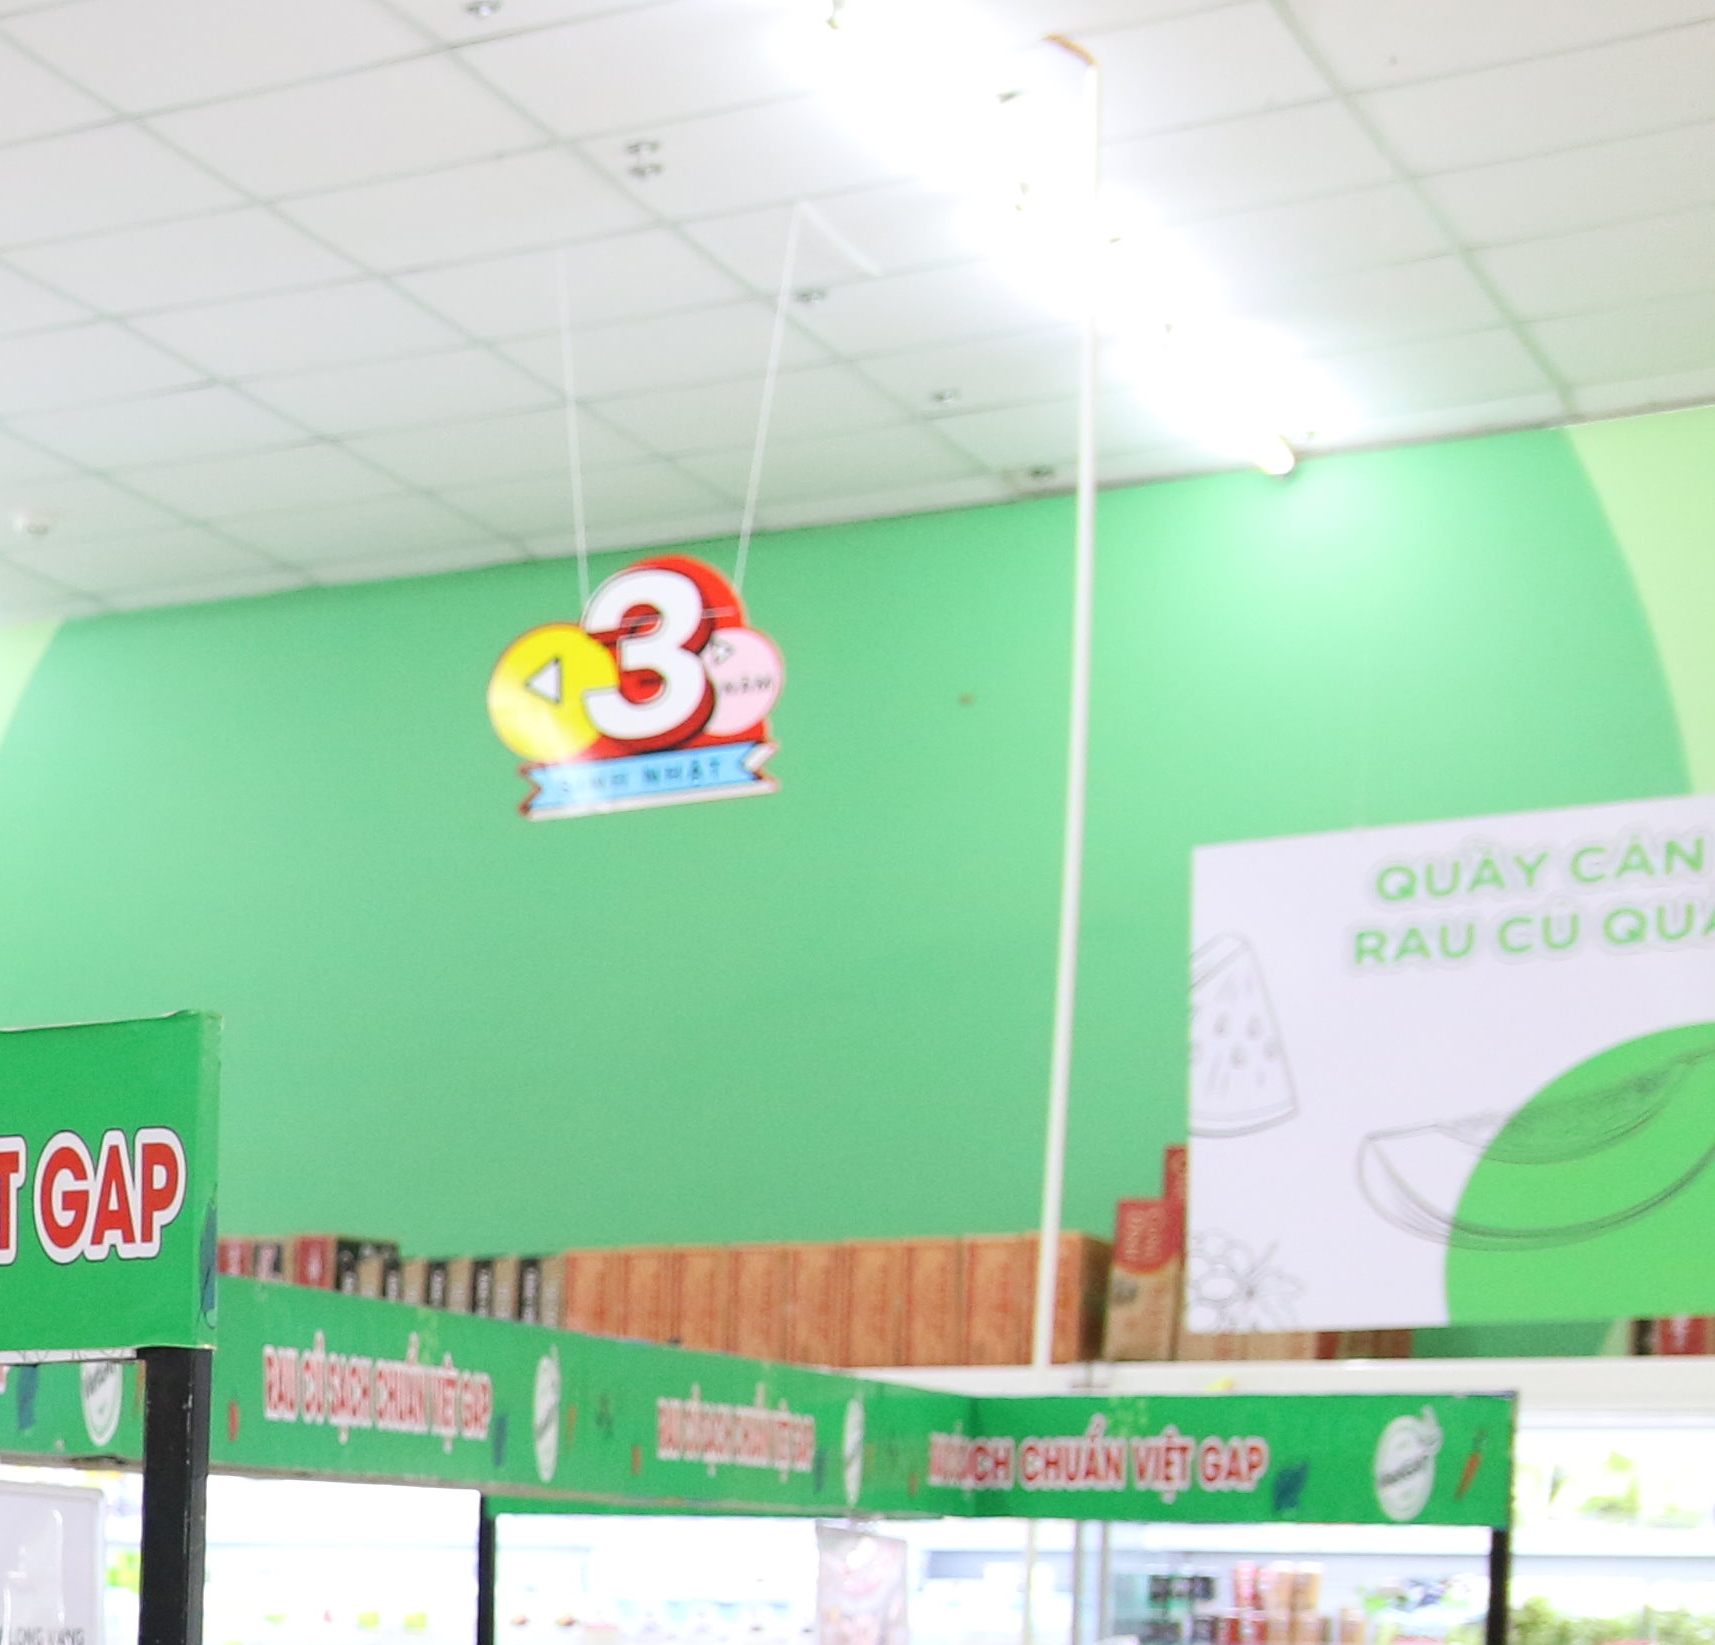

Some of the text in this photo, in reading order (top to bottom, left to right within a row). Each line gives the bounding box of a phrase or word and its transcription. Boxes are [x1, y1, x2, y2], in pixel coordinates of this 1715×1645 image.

[579, 568, 707, 741] 3
[1352, 919, 1477, 967] RAU
[35, 1130, 183, 1260] GAP
[1199, 1436, 1269, 1492] GAP
